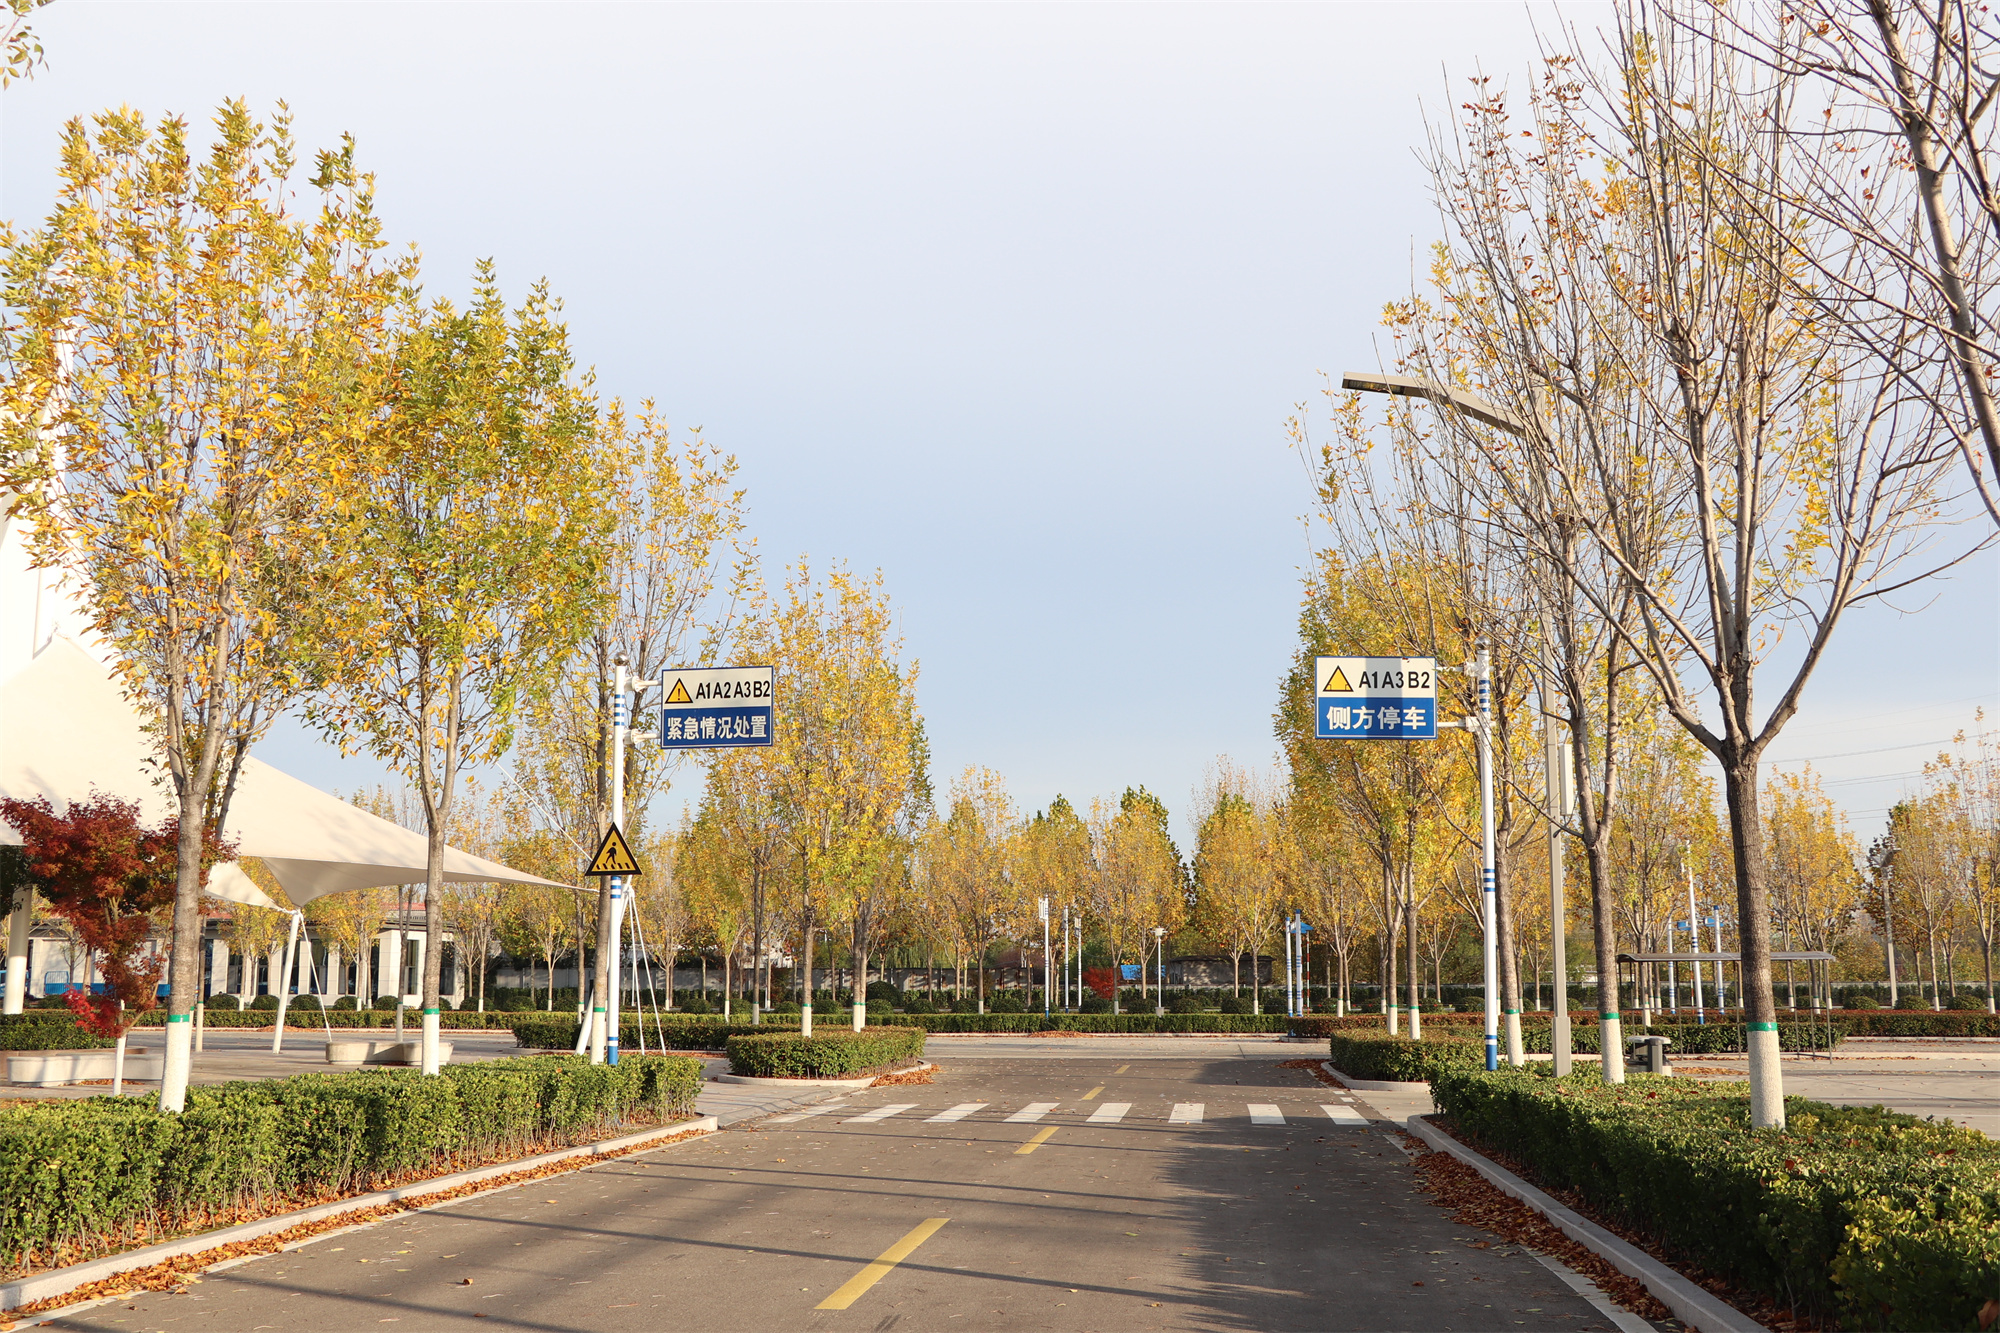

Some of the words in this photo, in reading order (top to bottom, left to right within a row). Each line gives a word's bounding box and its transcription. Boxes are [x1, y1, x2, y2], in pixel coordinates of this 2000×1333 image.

[667, 715, 767, 740] 紧急情况处置
[1326, 706, 1427, 730] 侧方停车
